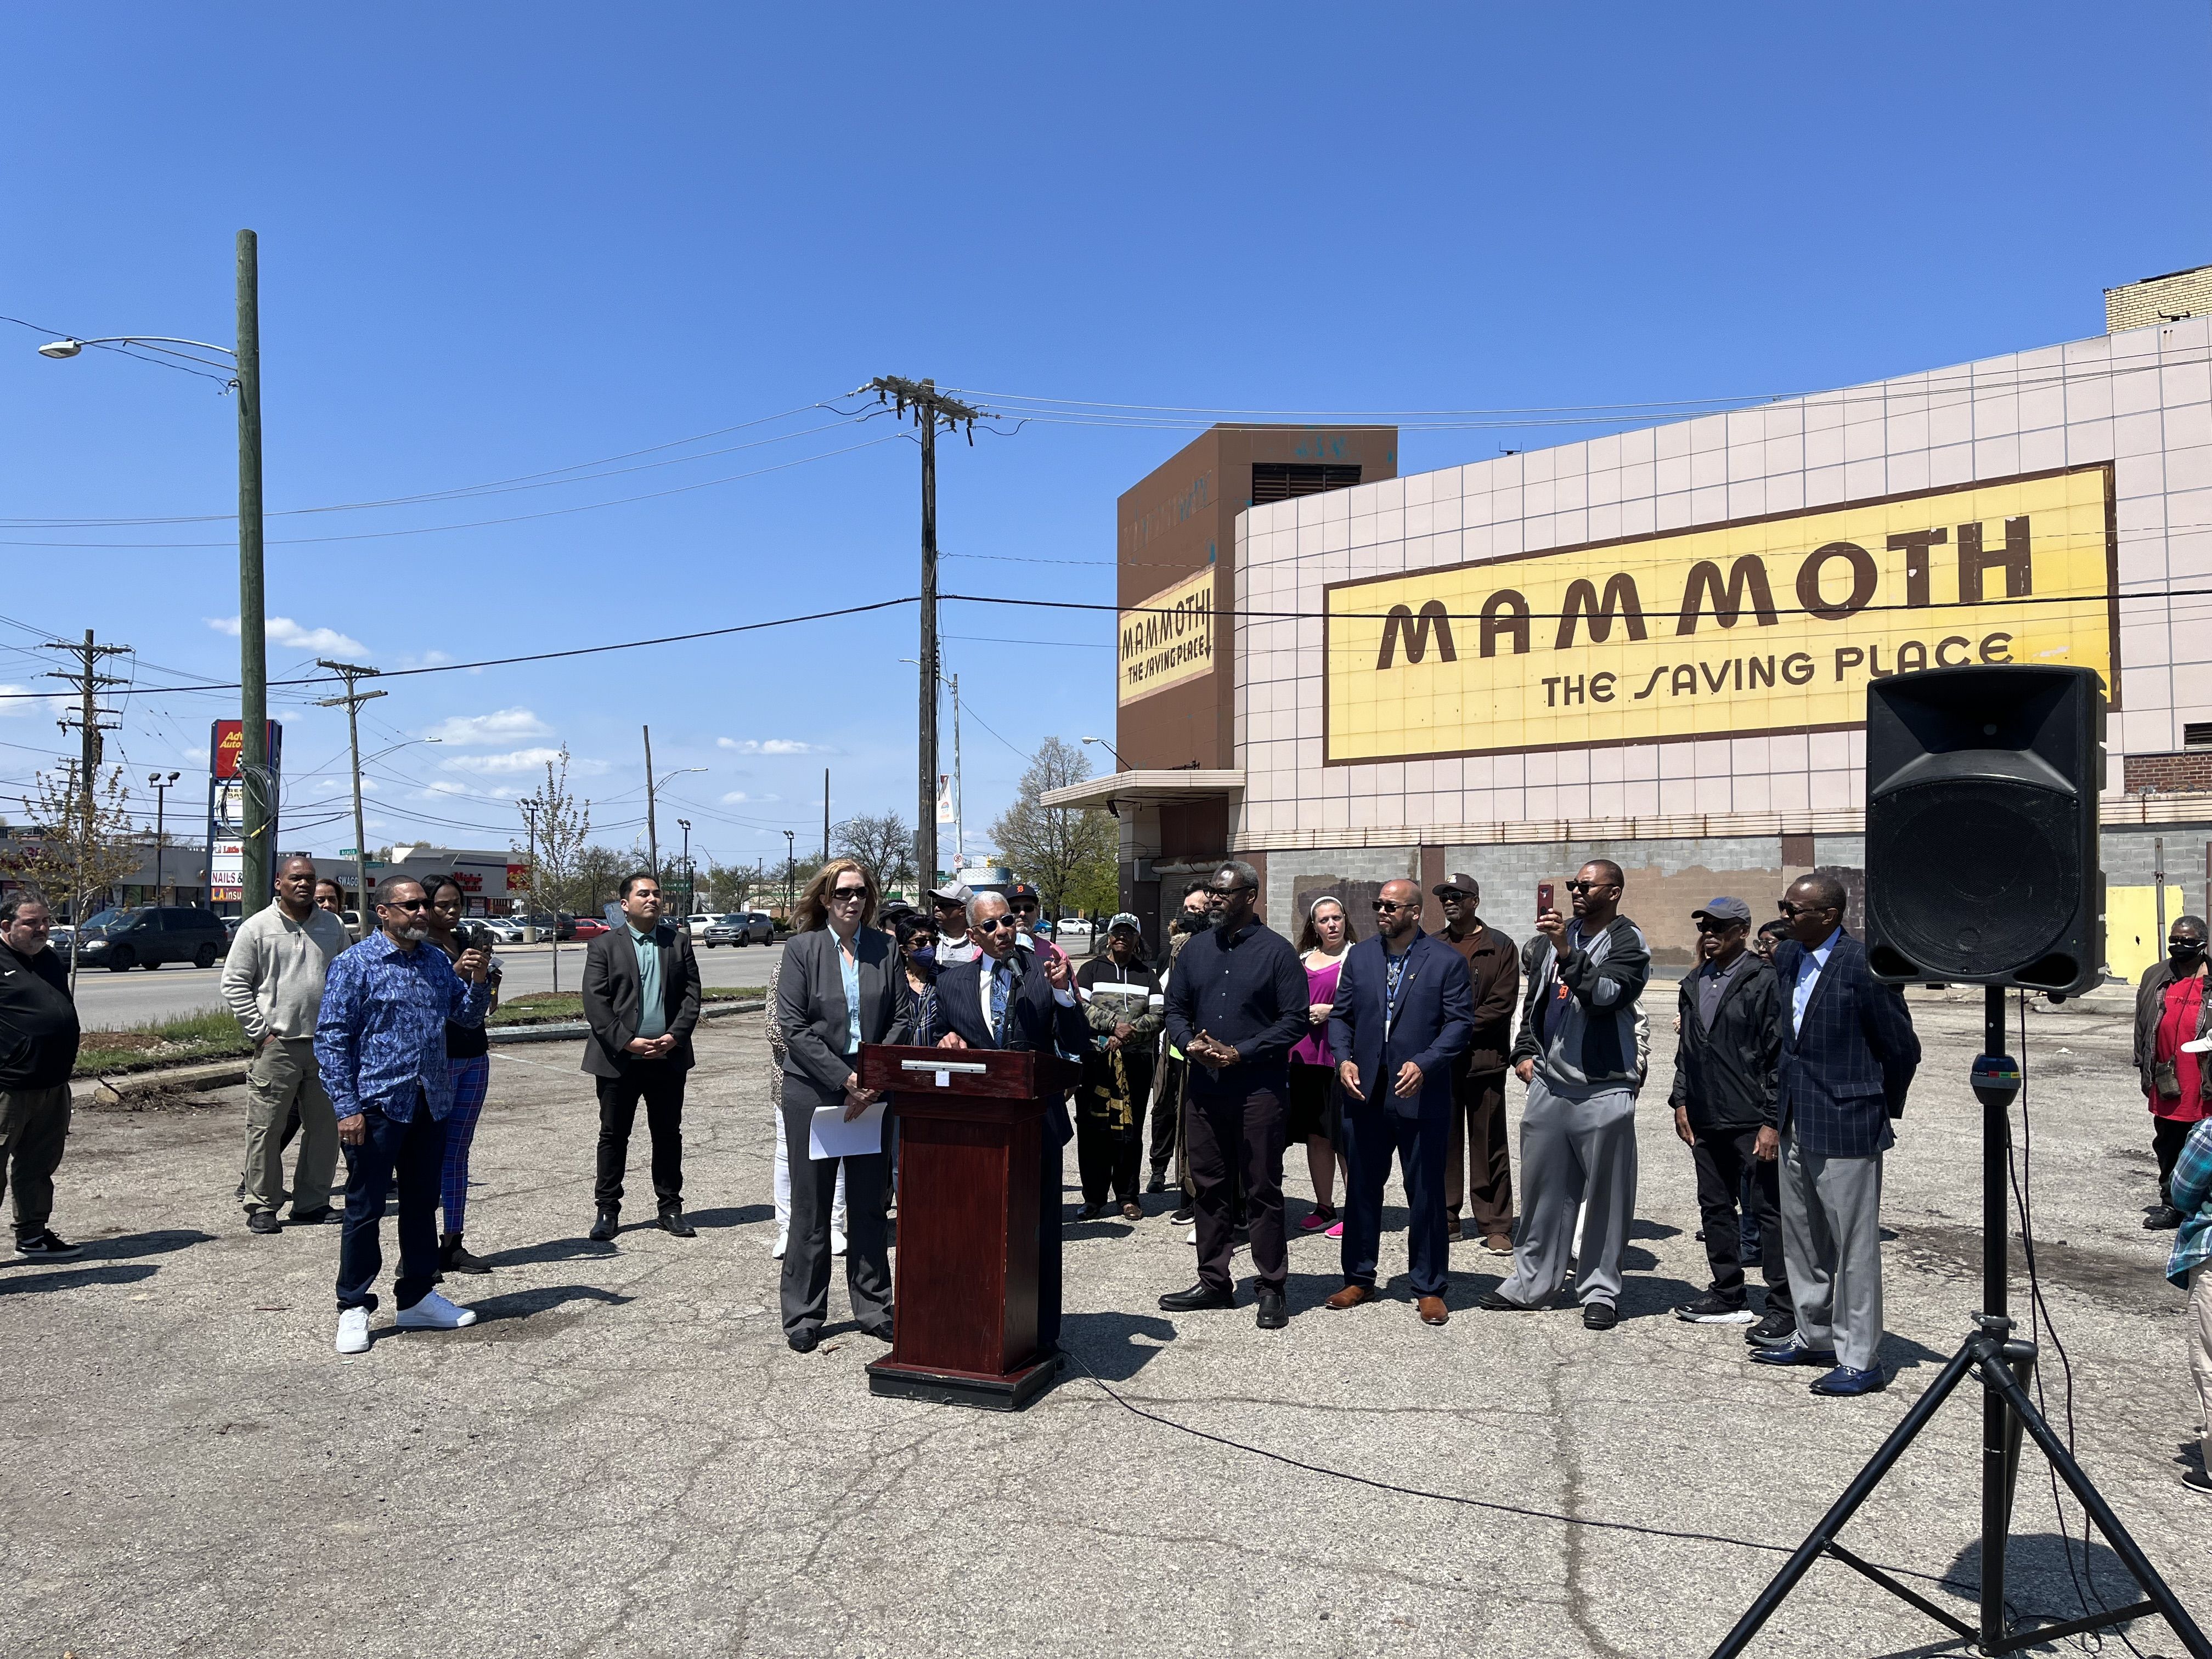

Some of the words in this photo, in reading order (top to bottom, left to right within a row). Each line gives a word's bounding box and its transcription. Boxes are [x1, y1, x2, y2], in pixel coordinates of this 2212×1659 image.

[1122, 589, 1205, 662] MAMMOTH
[1376, 515, 2032, 670] MAMMOTH
[1128, 662, 1143, 685] THE
[1145, 647, 1175, 679] SAVING
[1177, 635, 1204, 665] PLACE
[1542, 672, 1617, 707] THE
[1634, 652, 1814, 699] SAVING
[1836, 632, 2014, 681] PLACE
[212, 872, 235, 883] NAILS
